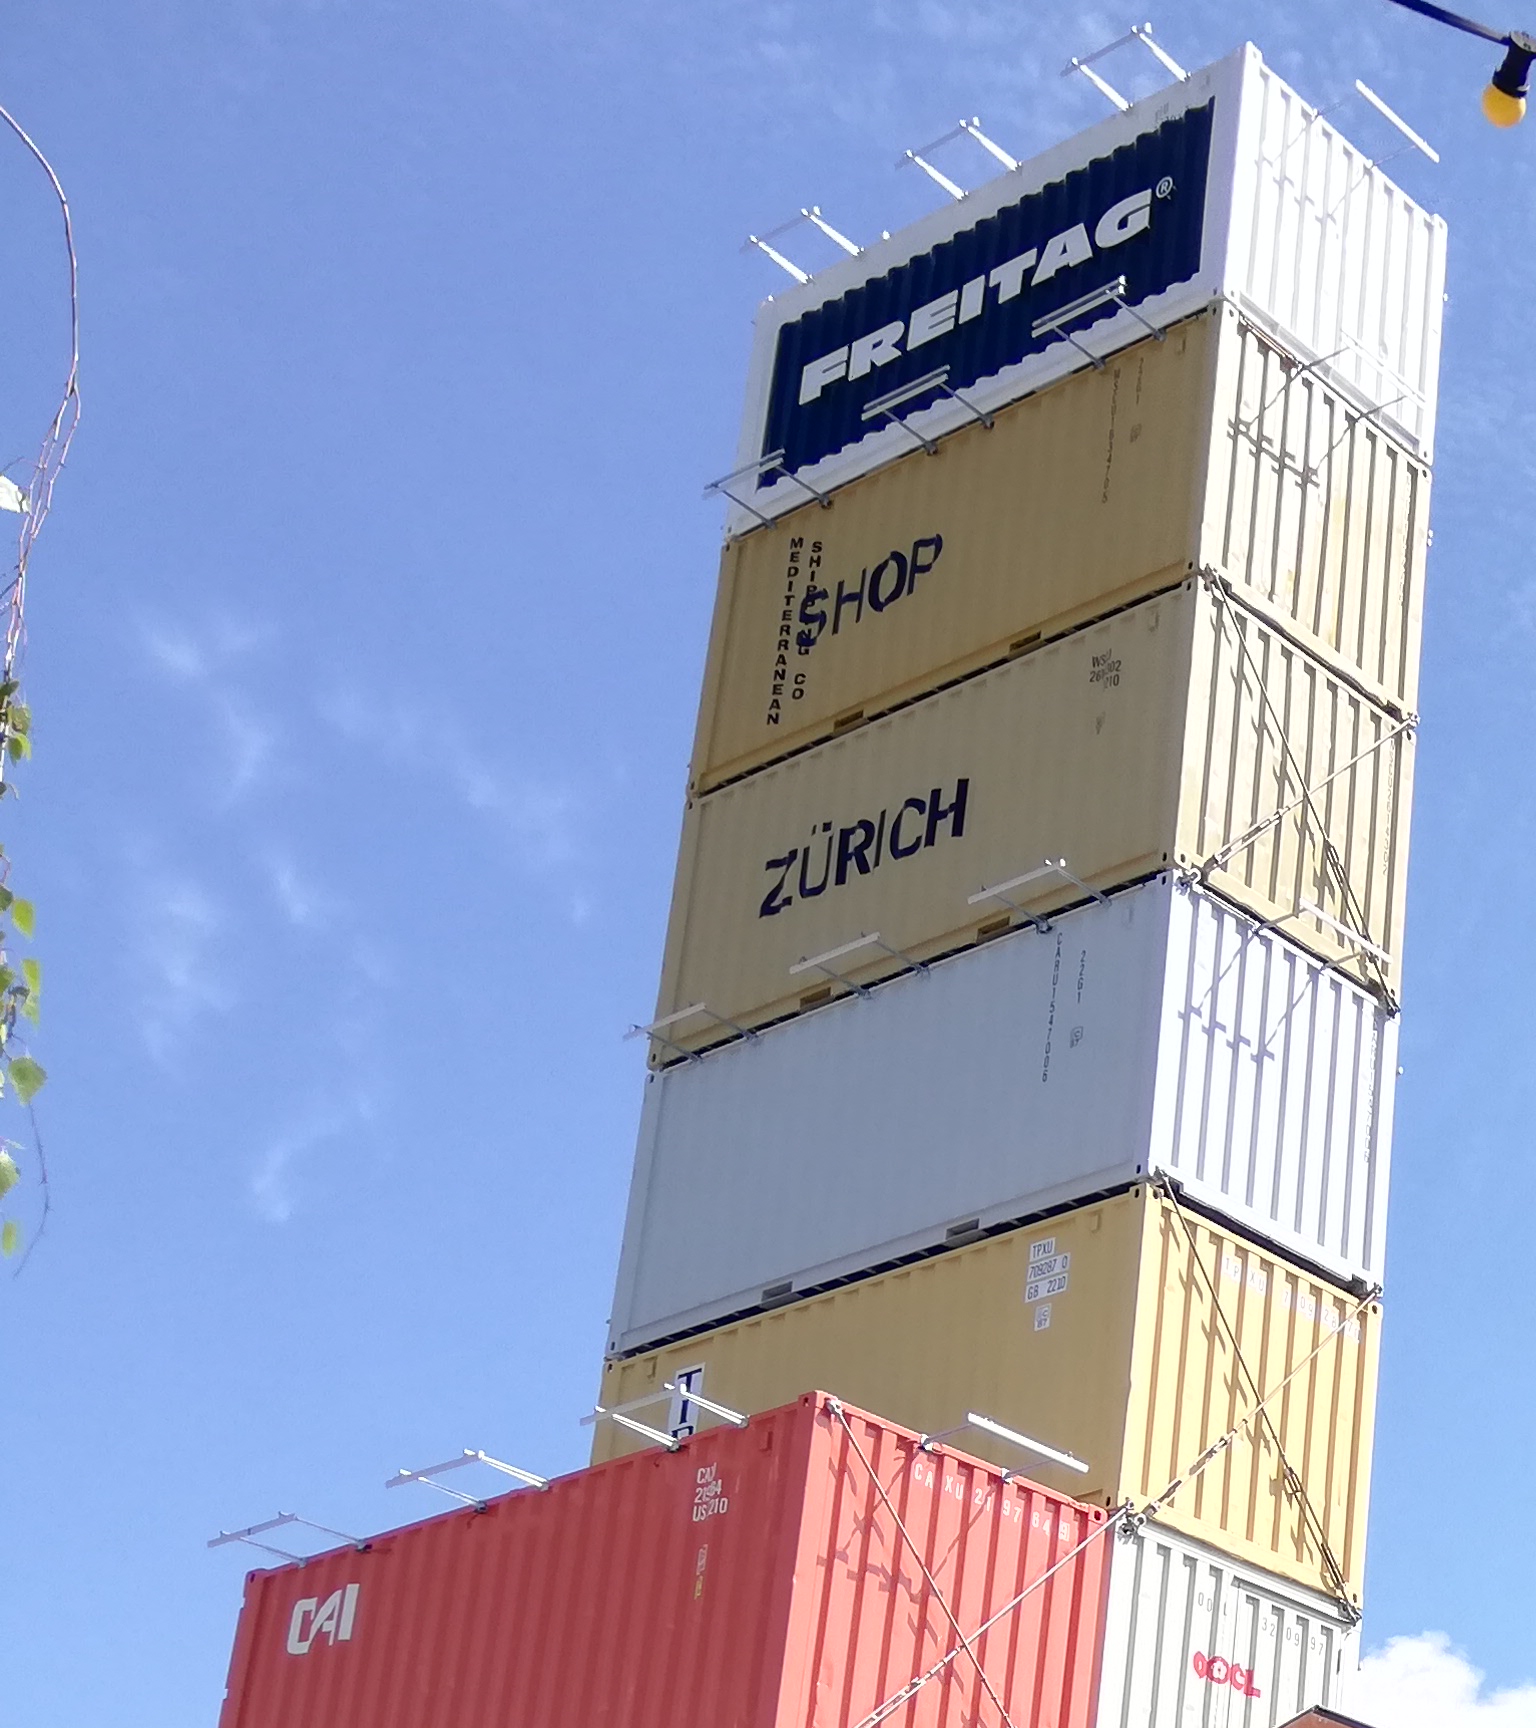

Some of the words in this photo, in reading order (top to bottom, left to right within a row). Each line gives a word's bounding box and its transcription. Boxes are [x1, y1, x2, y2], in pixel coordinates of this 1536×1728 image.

[766, 536, 804, 725] MEDITERRANEAN
[796, 533, 943, 647] SHOP
[791, 672, 807, 701] CO
[759, 777, 970, 919] ZÜRICH
[1032, 1239, 1054, 1259] TPXU
[287, 1583, 360, 1655] CAI
